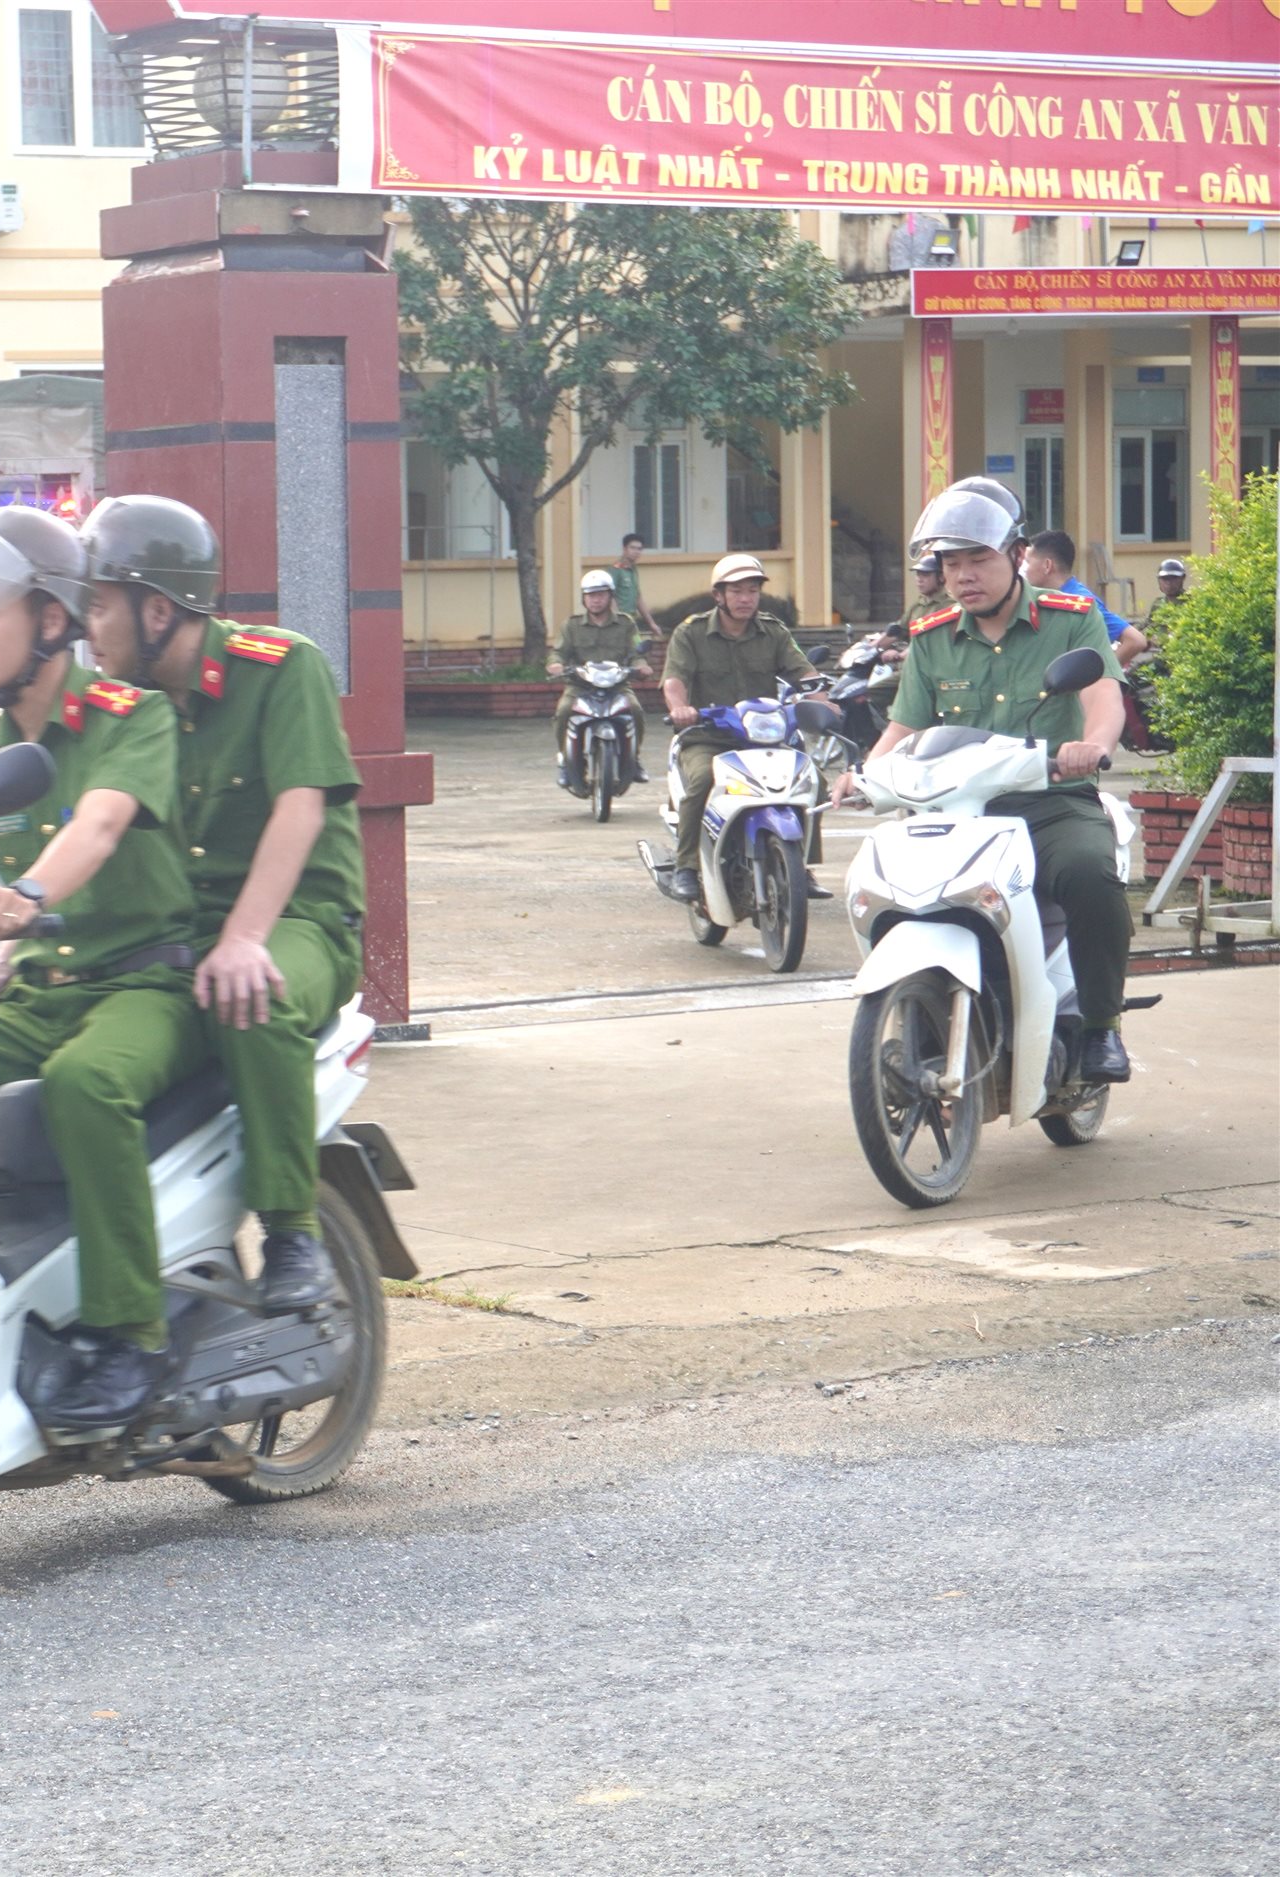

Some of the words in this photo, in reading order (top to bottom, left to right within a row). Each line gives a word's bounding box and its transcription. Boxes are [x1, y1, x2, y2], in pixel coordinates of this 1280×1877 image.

[607, 63, 692, 123] CÁN
[703, 69, 774, 143] BỘ,
[783, 66, 904, 132] CHIẾN
[915, 80, 953, 134] SĨ
[964, 81, 1064, 139] CÔNG
[1074, 98, 1123, 141] AN
[1134, 89, 1187, 143] XÃ
[1196, 92, 1269, 146] VĂN
[473, 132, 528, 181] KỶ
[541, 144, 646, 191] LUẬT
[658, 146, 763, 190] NHẤT
[802, 159, 929, 195] TRUNG
[939, 160, 1061, 199] THÀNH
[1070, 160, 1164, 201] NHẤT
[1200, 163, 1272, 205] GẦN
[1116, 270, 1158, 289] CÔNG
[1164, 273, 1186, 289] AN
